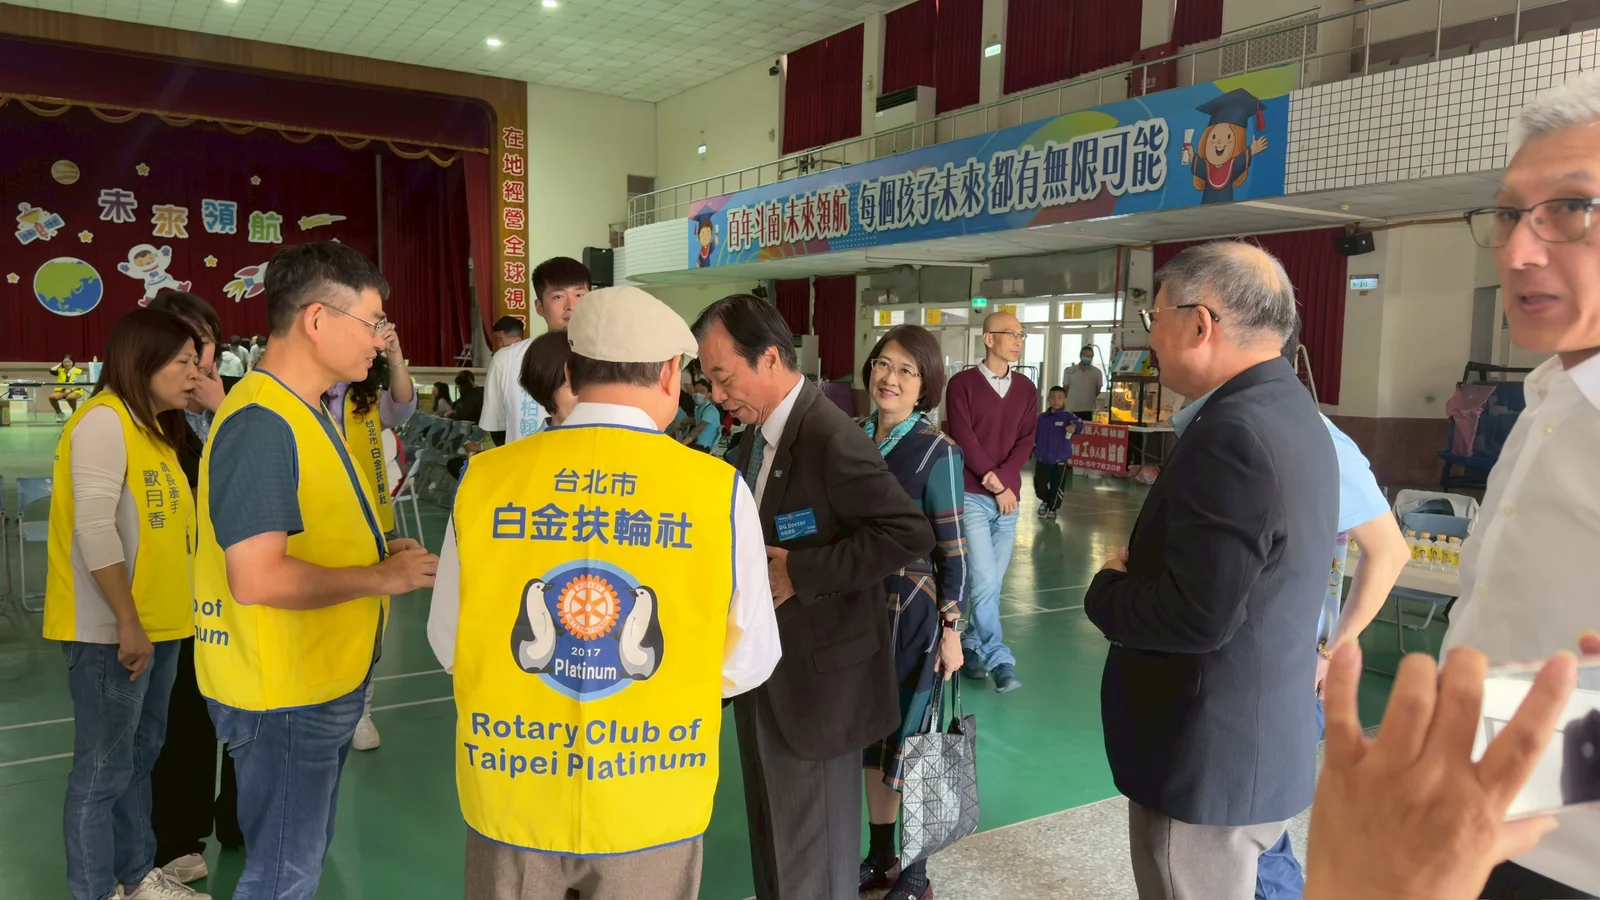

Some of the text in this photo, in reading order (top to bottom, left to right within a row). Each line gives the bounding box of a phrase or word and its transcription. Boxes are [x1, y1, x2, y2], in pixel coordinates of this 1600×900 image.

[727, 122, 1166, 252] 百年斗南 未來領航 每個孩子未來 都有無限可能
[98, 188, 282, 243] 未來領航
[554, 468, 638, 497] 台北市
[492, 502, 693, 549] 白金扶輪社
[201, 598, 222, 617] of
[555, 658, 617, 680] Platinum
[571, 646, 601, 657] 2017
[471, 712, 703, 748] Rotary Club of
[463, 742, 707, 780] Taipei Platinum
